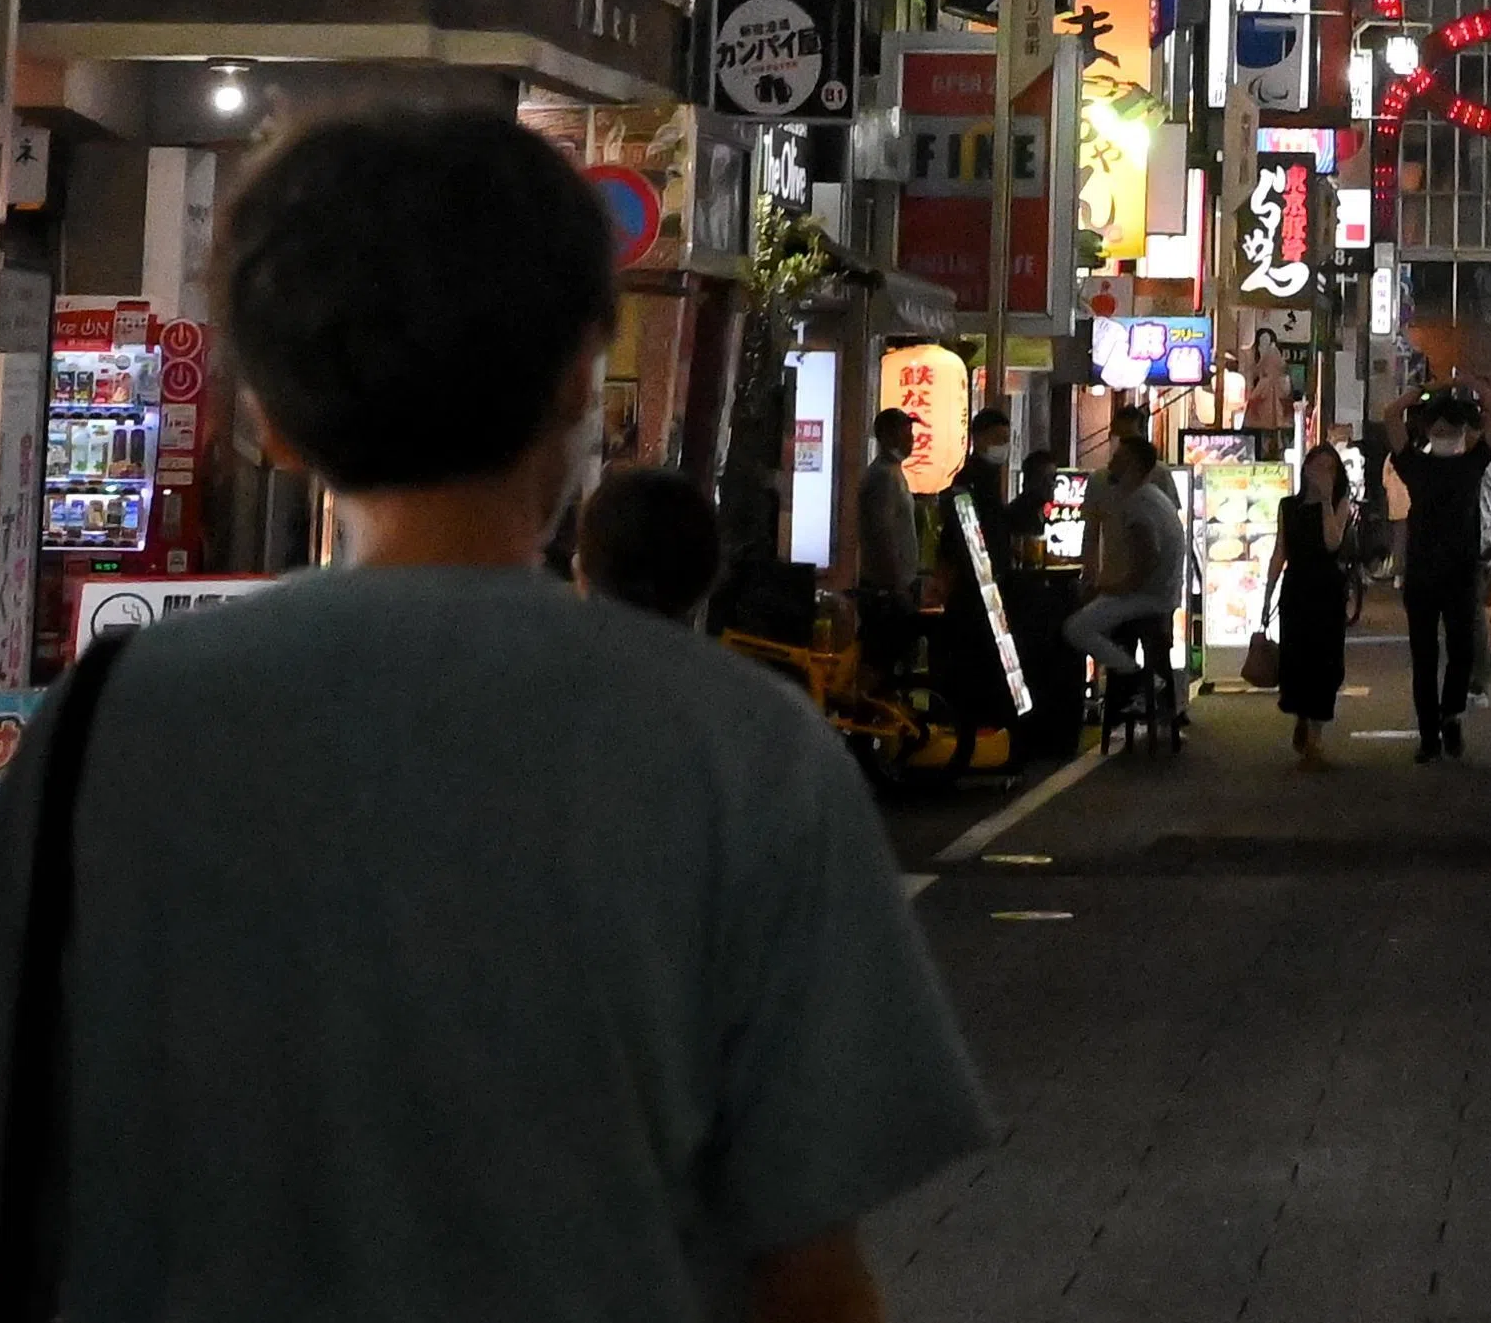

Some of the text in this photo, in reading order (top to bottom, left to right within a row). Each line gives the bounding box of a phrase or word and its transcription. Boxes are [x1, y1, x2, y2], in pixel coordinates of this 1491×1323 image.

[716, 30, 823, 71] カンパイ屋
